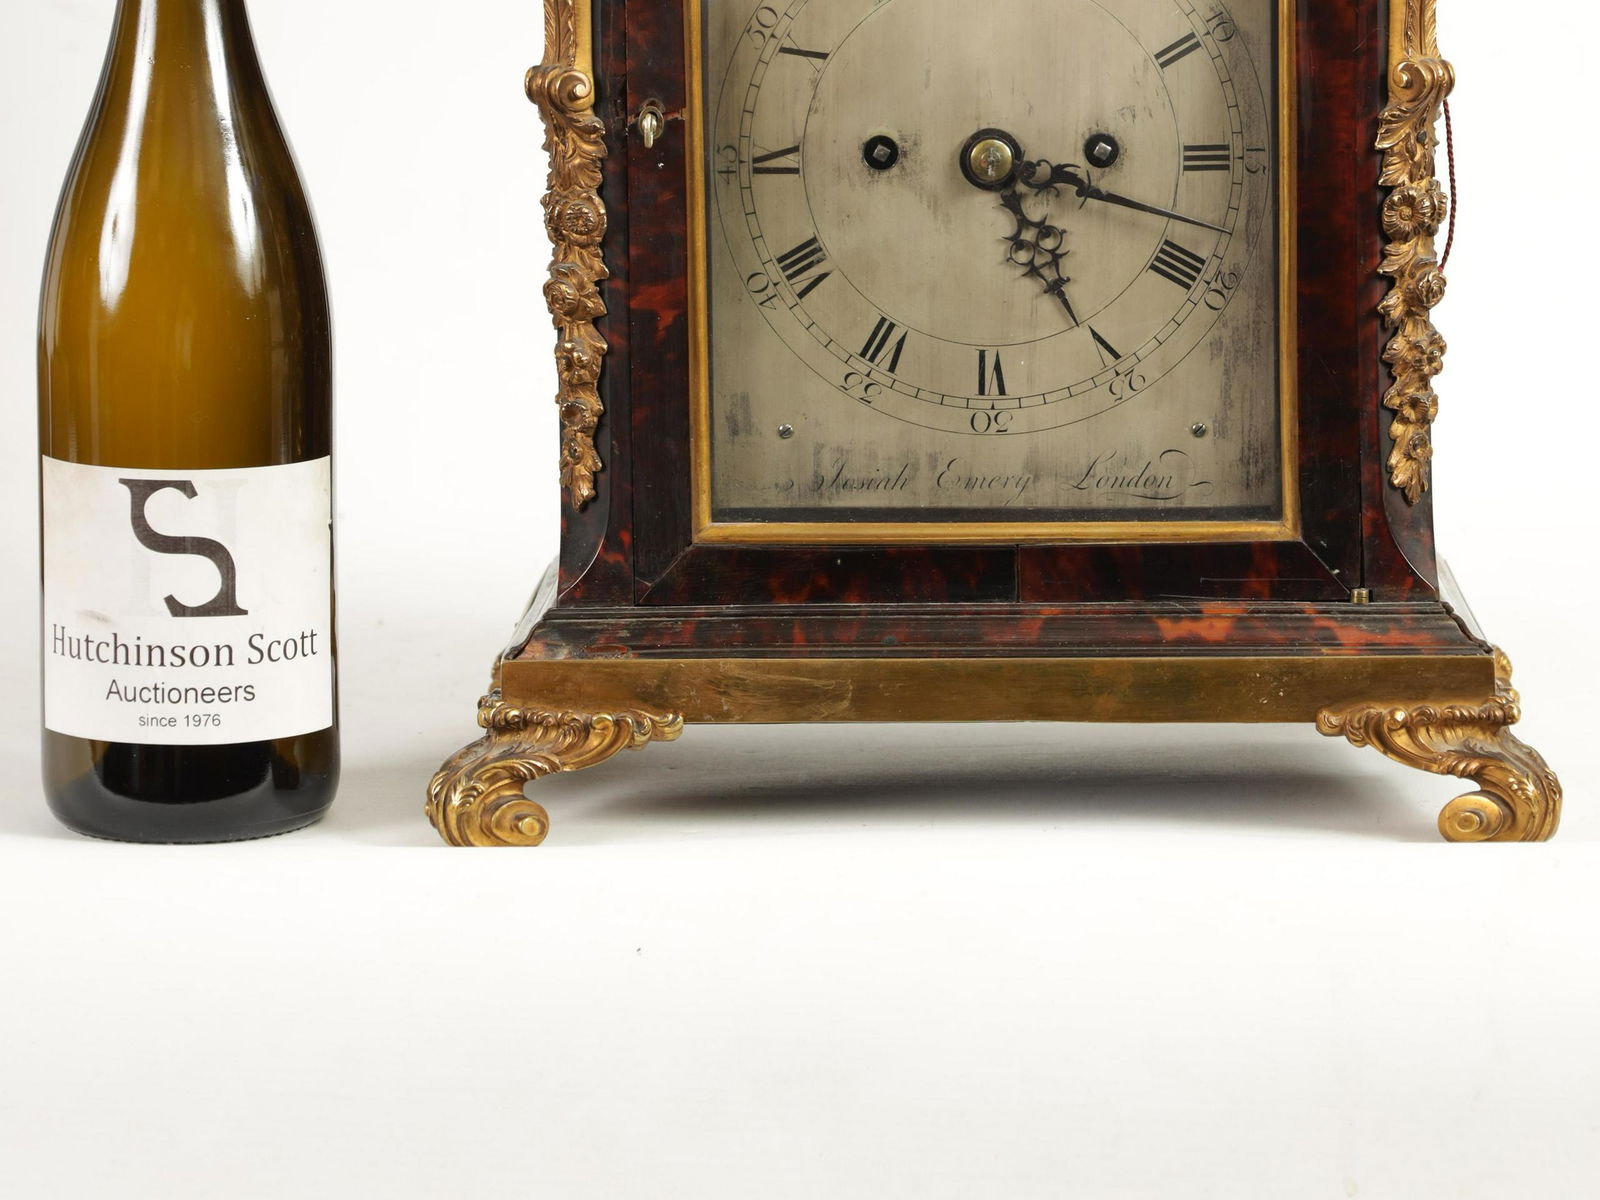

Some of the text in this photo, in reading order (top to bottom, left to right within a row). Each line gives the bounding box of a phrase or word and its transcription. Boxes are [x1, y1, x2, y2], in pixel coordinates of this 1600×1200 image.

[746, 6, 779, 50] 50
[1206, 10, 1236, 43] 10
[775, 30, 833, 73] X
[1153, 31, 1204, 74] II
[716, 144, 739, 186] 45
[752, 142, 801, 179] IX
[1182, 143, 1231, 176] III
[1244, 144, 1268, 176] 15
[773, 232, 835, 303] VIII
[1146, 235, 1209, 295] IIII
[747, 271, 778, 311] 40
[1203, 269, 1238, 312] 20
[855, 313, 909, 376] VII
[1087, 324, 1128, 371] V
[839, 370, 883, 404] 35
[975, 348, 1010, 397] VI
[1108, 367, 1147, 402] 25
[969, 410, 1014, 434] 30
[814, 450, 1175, 506] Josiah Emery London
[52, 623, 318, 668] Hutchinson Scott
[105, 679, 256, 705] Auctioneers
[138, 713, 222, 728] since 1976
